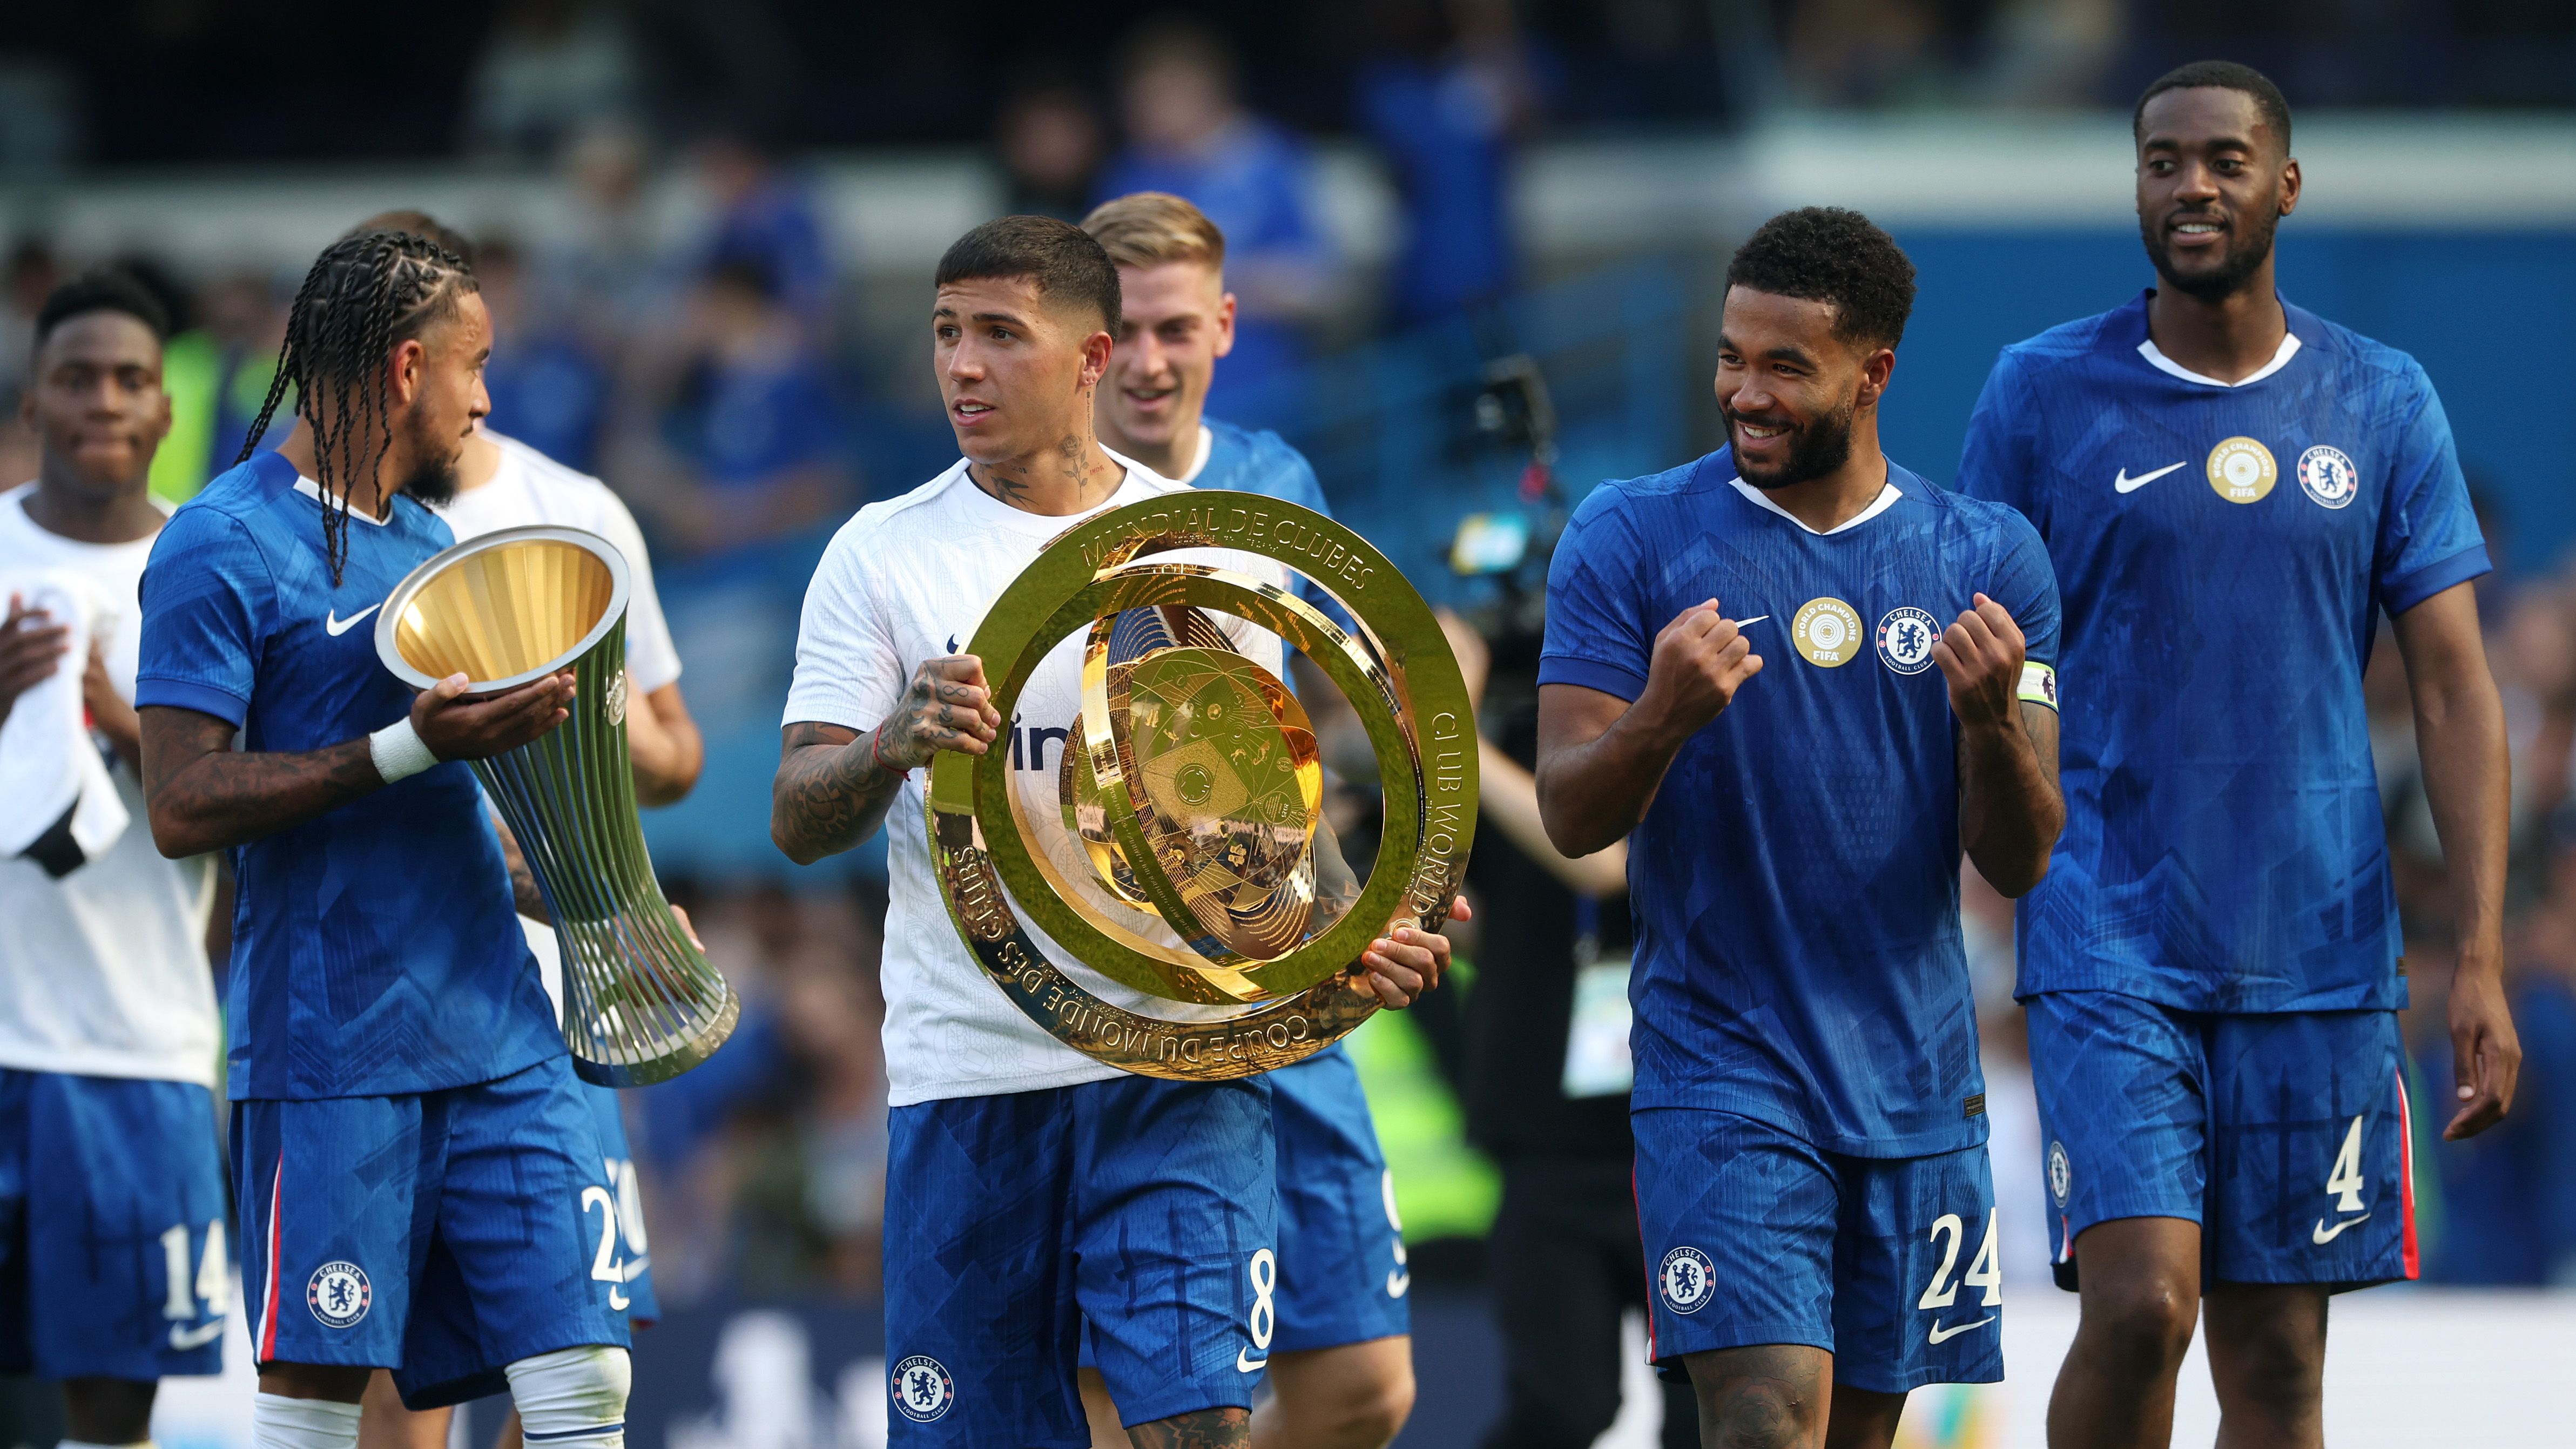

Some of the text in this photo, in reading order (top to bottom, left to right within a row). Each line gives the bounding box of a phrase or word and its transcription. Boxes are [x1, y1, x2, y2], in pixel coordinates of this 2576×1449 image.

[2214, 443, 2270, 478] WORLD CHAMPIONS
[2308, 448, 2345, 464] CHELSEA
[2229, 487, 2257, 497] FIFA
[1080, 508, 1219, 567] MUNDIAL
[1227, 509, 1267, 536] DE
[1273, 520, 1374, 589] CLUBES
[1799, 603, 1856, 642] WORLD CHAMPIONS
[1889, 609, 1931, 626] CHELSEA
[1813, 650, 1839, 661] FIFA
[1885, 655, 1927, 671] FOOTBALL CLUB
[1408, 712, 1462, 916] CLUB WORLD
[954, 846, 1310, 1062] COUPE DU MONDE DES CLUBS
[2326, 1114, 2365, 1212] 4
[1665, 1249, 1701, 1266] CHELSEA
[1918, 1207, 2001, 1310] 24
[160, 1218, 232, 1320] 14
[319, 1264, 361, 1279] CHELSEA
[1250, 1248, 1276, 1350] 8
[1669, 1295, 1707, 1311] FOOTBALL CLUB
[318, 1311, 360, 1324] FOOTBALL CLUB
[900, 1358, 939, 1372] CHELSEA
[903, 1406, 945, 1419] FOOTBALL CLUB
